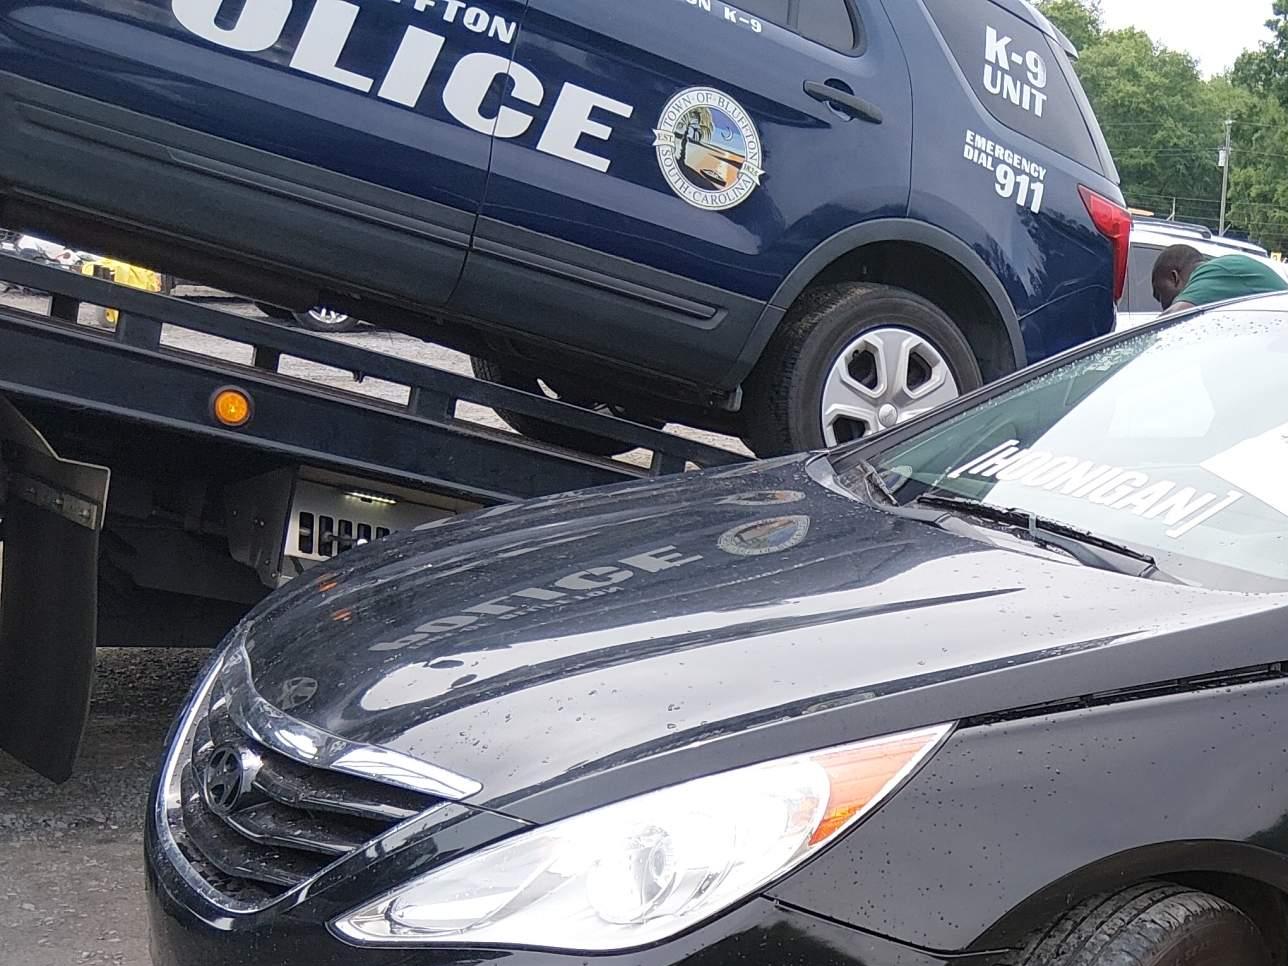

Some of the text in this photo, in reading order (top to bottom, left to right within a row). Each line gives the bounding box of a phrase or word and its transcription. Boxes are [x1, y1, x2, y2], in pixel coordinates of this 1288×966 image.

[391, 0, 517, 44] FTON
[724, 7, 762, 33] K-9
[985, 25, 1047, 88] K-9
[983, 64, 1047, 118] UNIT
[663, 92, 758, 160] TOWN OF BLUFFTON
[661, 149, 752, 206] SOUTH CAROLINA
[963, 144, 1045, 215] DIAL 911
[966, 129, 1047, 180] EMERGENCY
